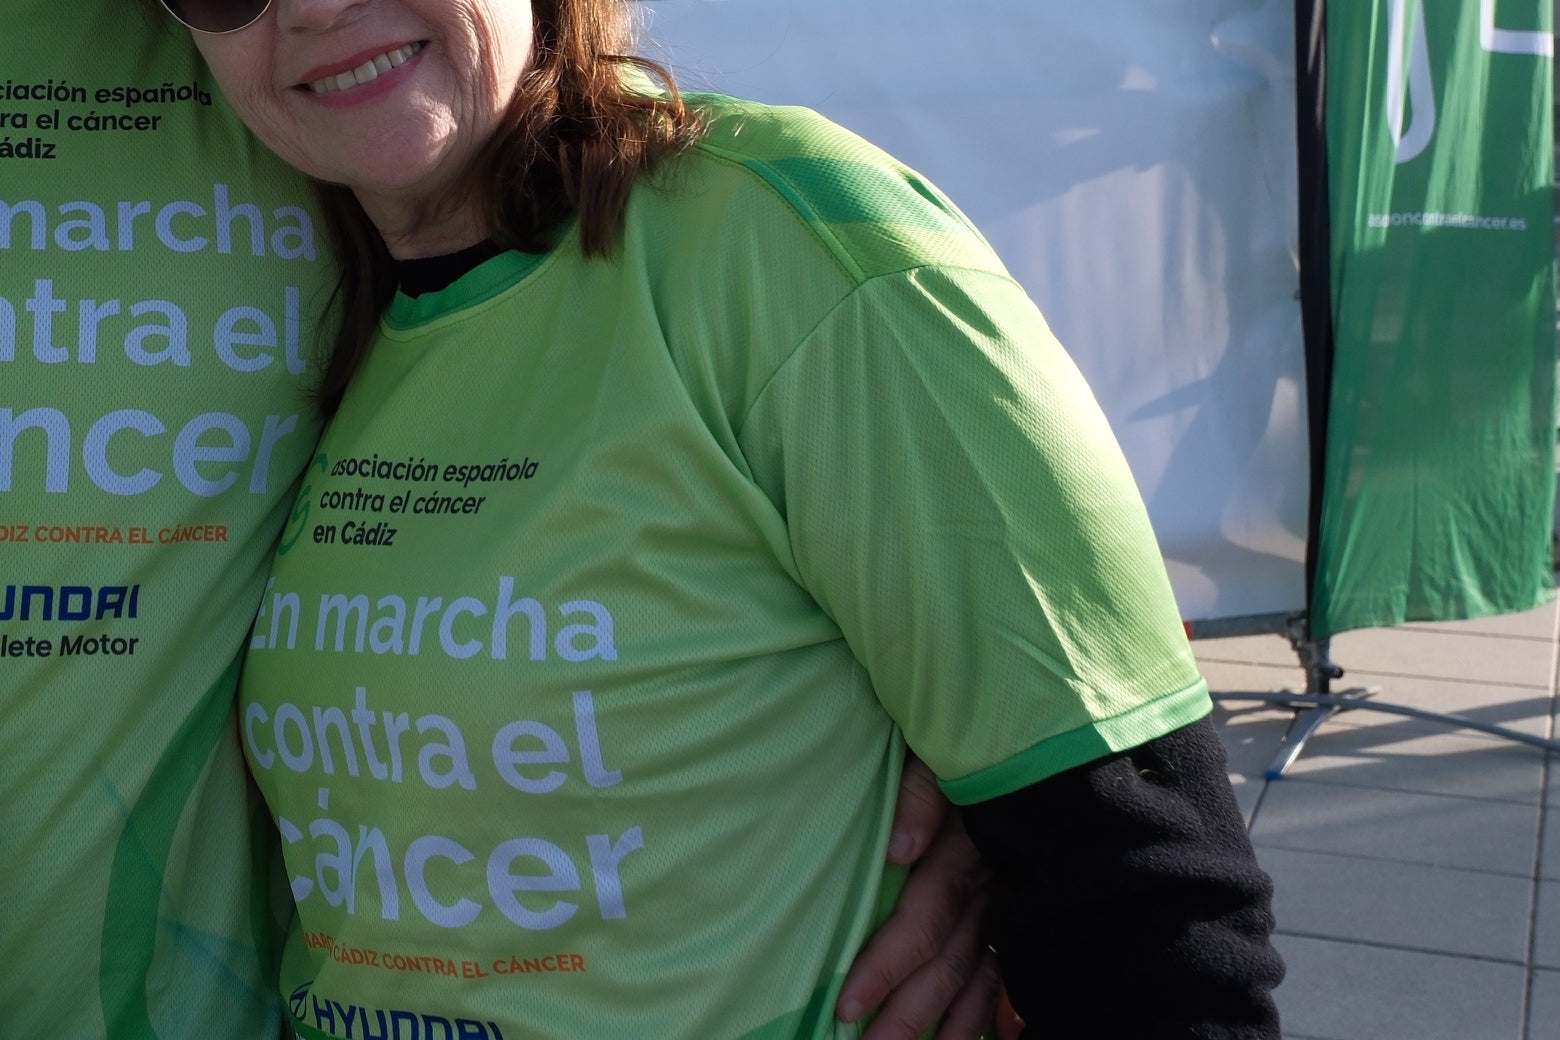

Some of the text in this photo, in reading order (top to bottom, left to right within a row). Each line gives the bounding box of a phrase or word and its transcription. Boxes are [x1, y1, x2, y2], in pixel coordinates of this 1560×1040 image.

[94, 80, 213, 108] española
[35, 109, 61, 131] el
[67, 109, 162, 132] cáncer
[213, 286, 306, 375] el
[330, 453, 539, 488] asociación española
[320, 487, 486, 515] contra el cáncer
[34, 525, 124, 544] CONTRA
[128, 525, 153, 545] EL
[158, 520, 228, 545] CÁNCER
[312, 520, 397, 547] en Cádiz
[315, 575, 618, 662] marcha
[58, 633, 140, 657] Motor
[245, 686, 623, 795] contra el
[383, 953, 459, 979] CONTRA
[462, 961, 489, 980] EL
[493, 954, 586, 975] CÁNCER
